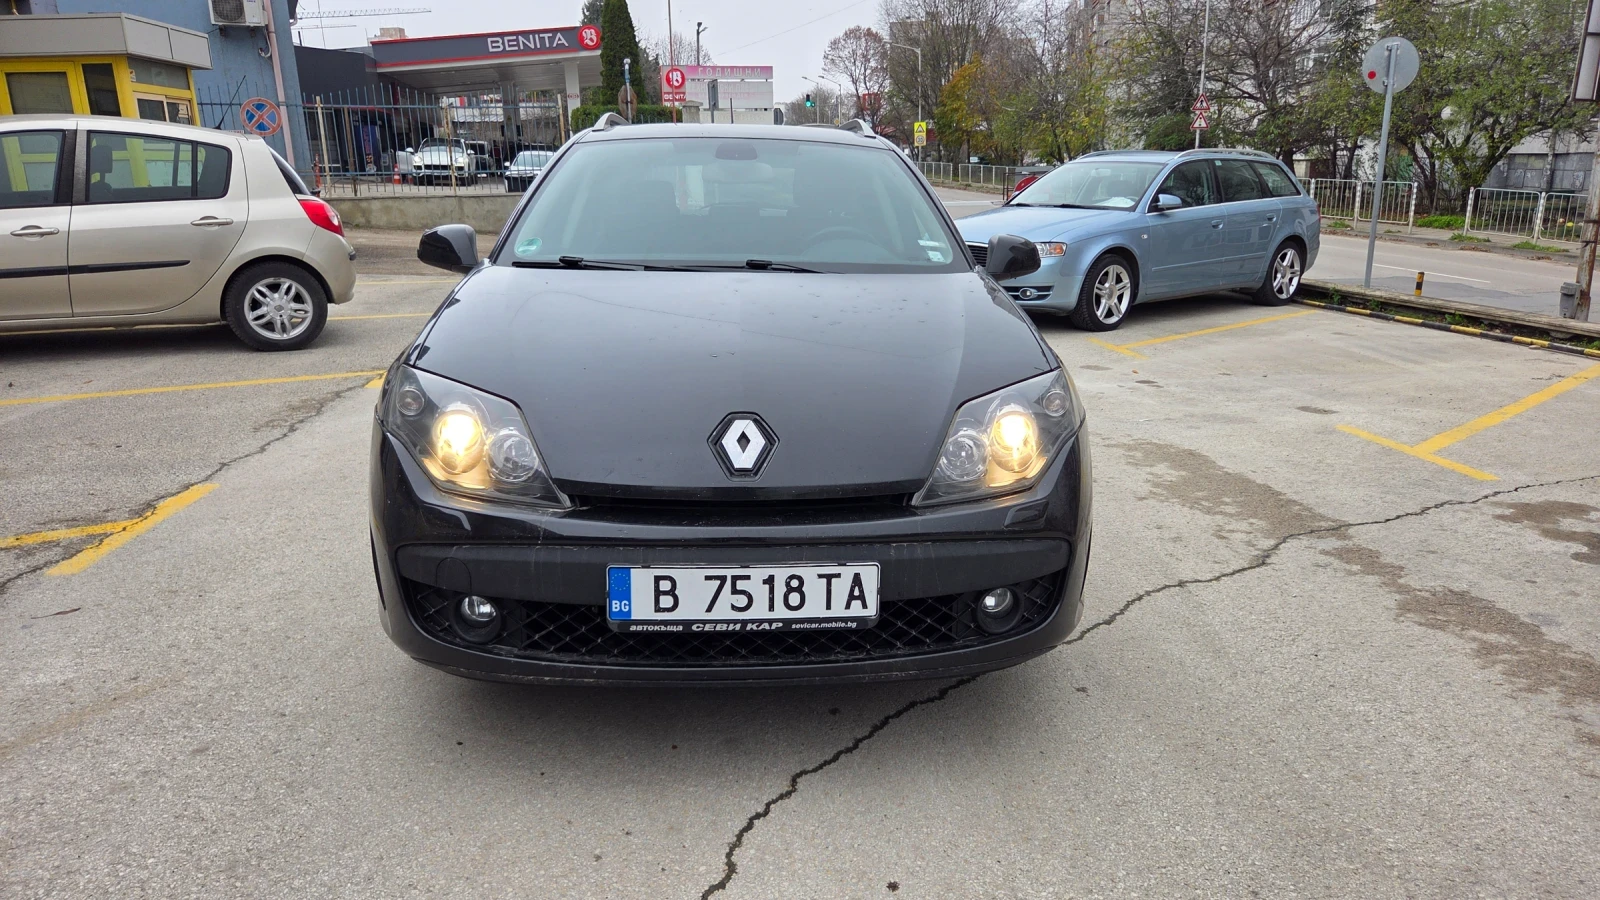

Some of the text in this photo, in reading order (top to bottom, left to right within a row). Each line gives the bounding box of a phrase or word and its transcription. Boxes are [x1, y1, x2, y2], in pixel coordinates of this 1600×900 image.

[487, 32, 569, 53] BENITA
[698, 67, 761, 77] ГОДИШНИ
[653, 572, 869, 613] B 7518 TA
[611, 600, 630, 612] BG
[629, 622, 784, 632] автокъща СЕВИ КАР
[791, 621, 857, 629] sevicar.mobile.bg
